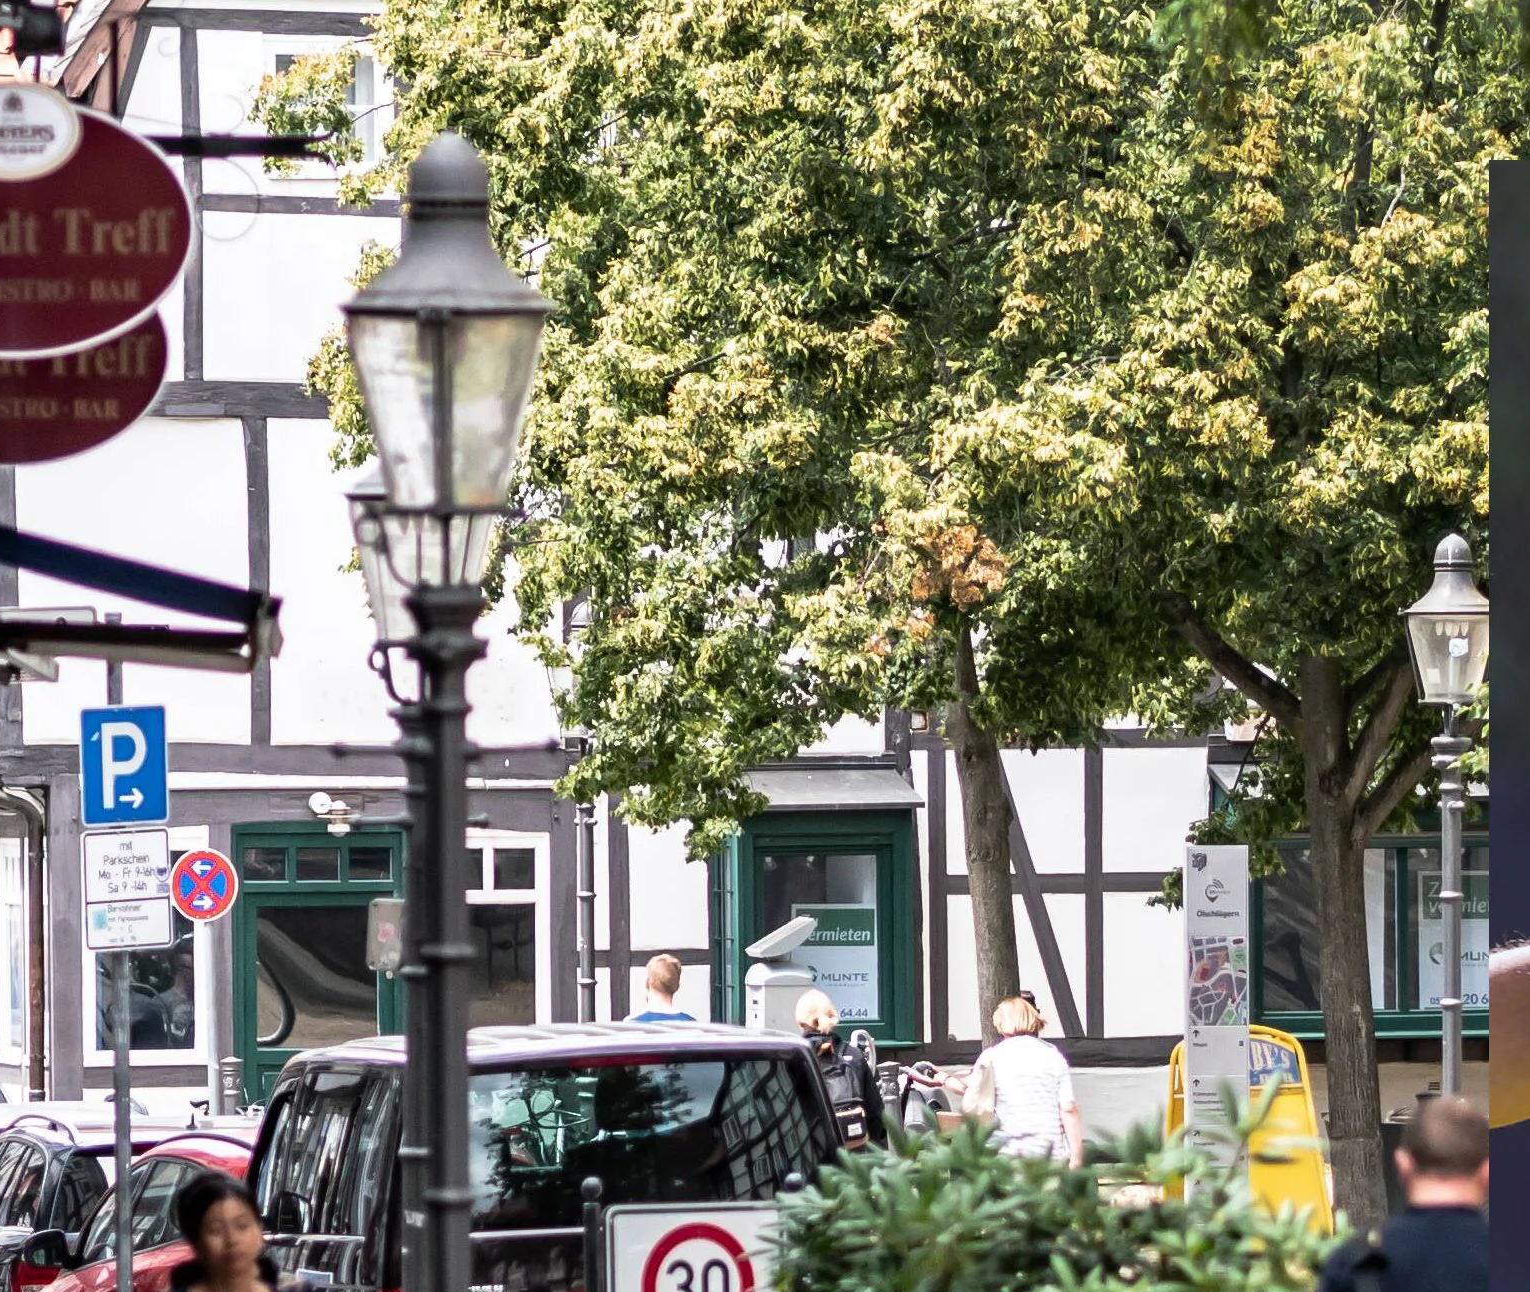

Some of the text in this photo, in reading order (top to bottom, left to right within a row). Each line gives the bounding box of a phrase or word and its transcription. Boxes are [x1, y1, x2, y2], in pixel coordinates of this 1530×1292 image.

[53, 207, 176, 256] Treff
[90, 278, 142, 301] BAR
[74, 398, 121, 419] BAR
[101, 721, 147, 809] P
[103, 854, 150, 866] Parkschein
[122, 868, 131, 879] Fr
[108, 882, 119, 893] Sa
[808, 926, 871, 941] ermieten
[821, 972, 869, 982] MUNTE
